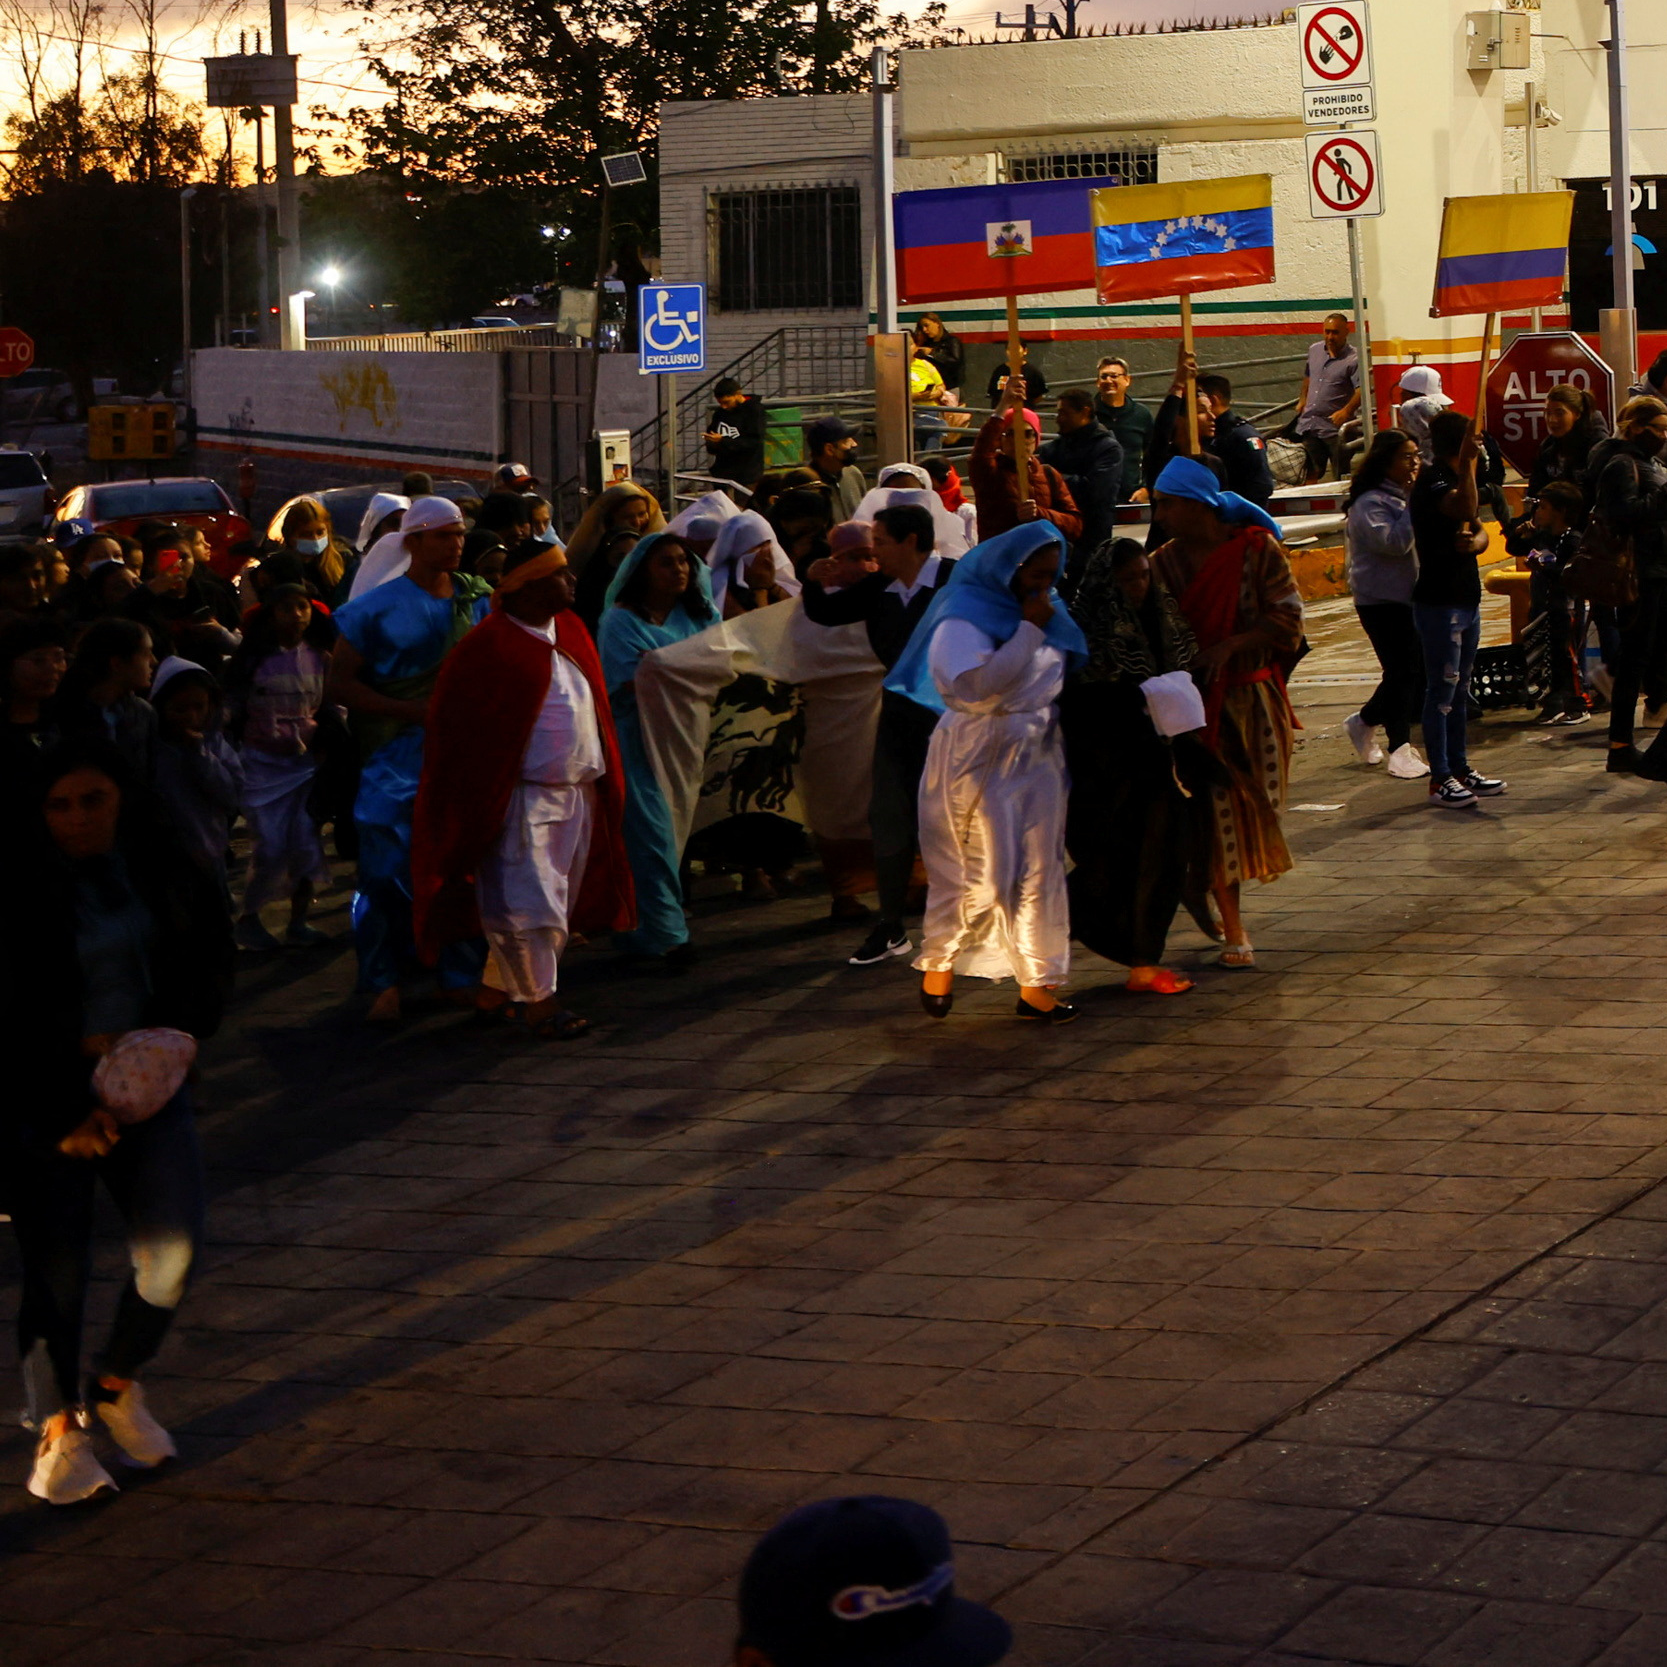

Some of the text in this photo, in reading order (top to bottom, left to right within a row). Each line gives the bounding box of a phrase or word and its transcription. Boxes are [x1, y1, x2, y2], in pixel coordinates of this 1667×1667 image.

[1312, 94, 1363, 105] PROHIBIDO
[1308, 105, 1370, 118] VENDEDORES
[646, 353, 699, 366] EXCLUSIVO
[1503, 411, 1544, 441] ST
